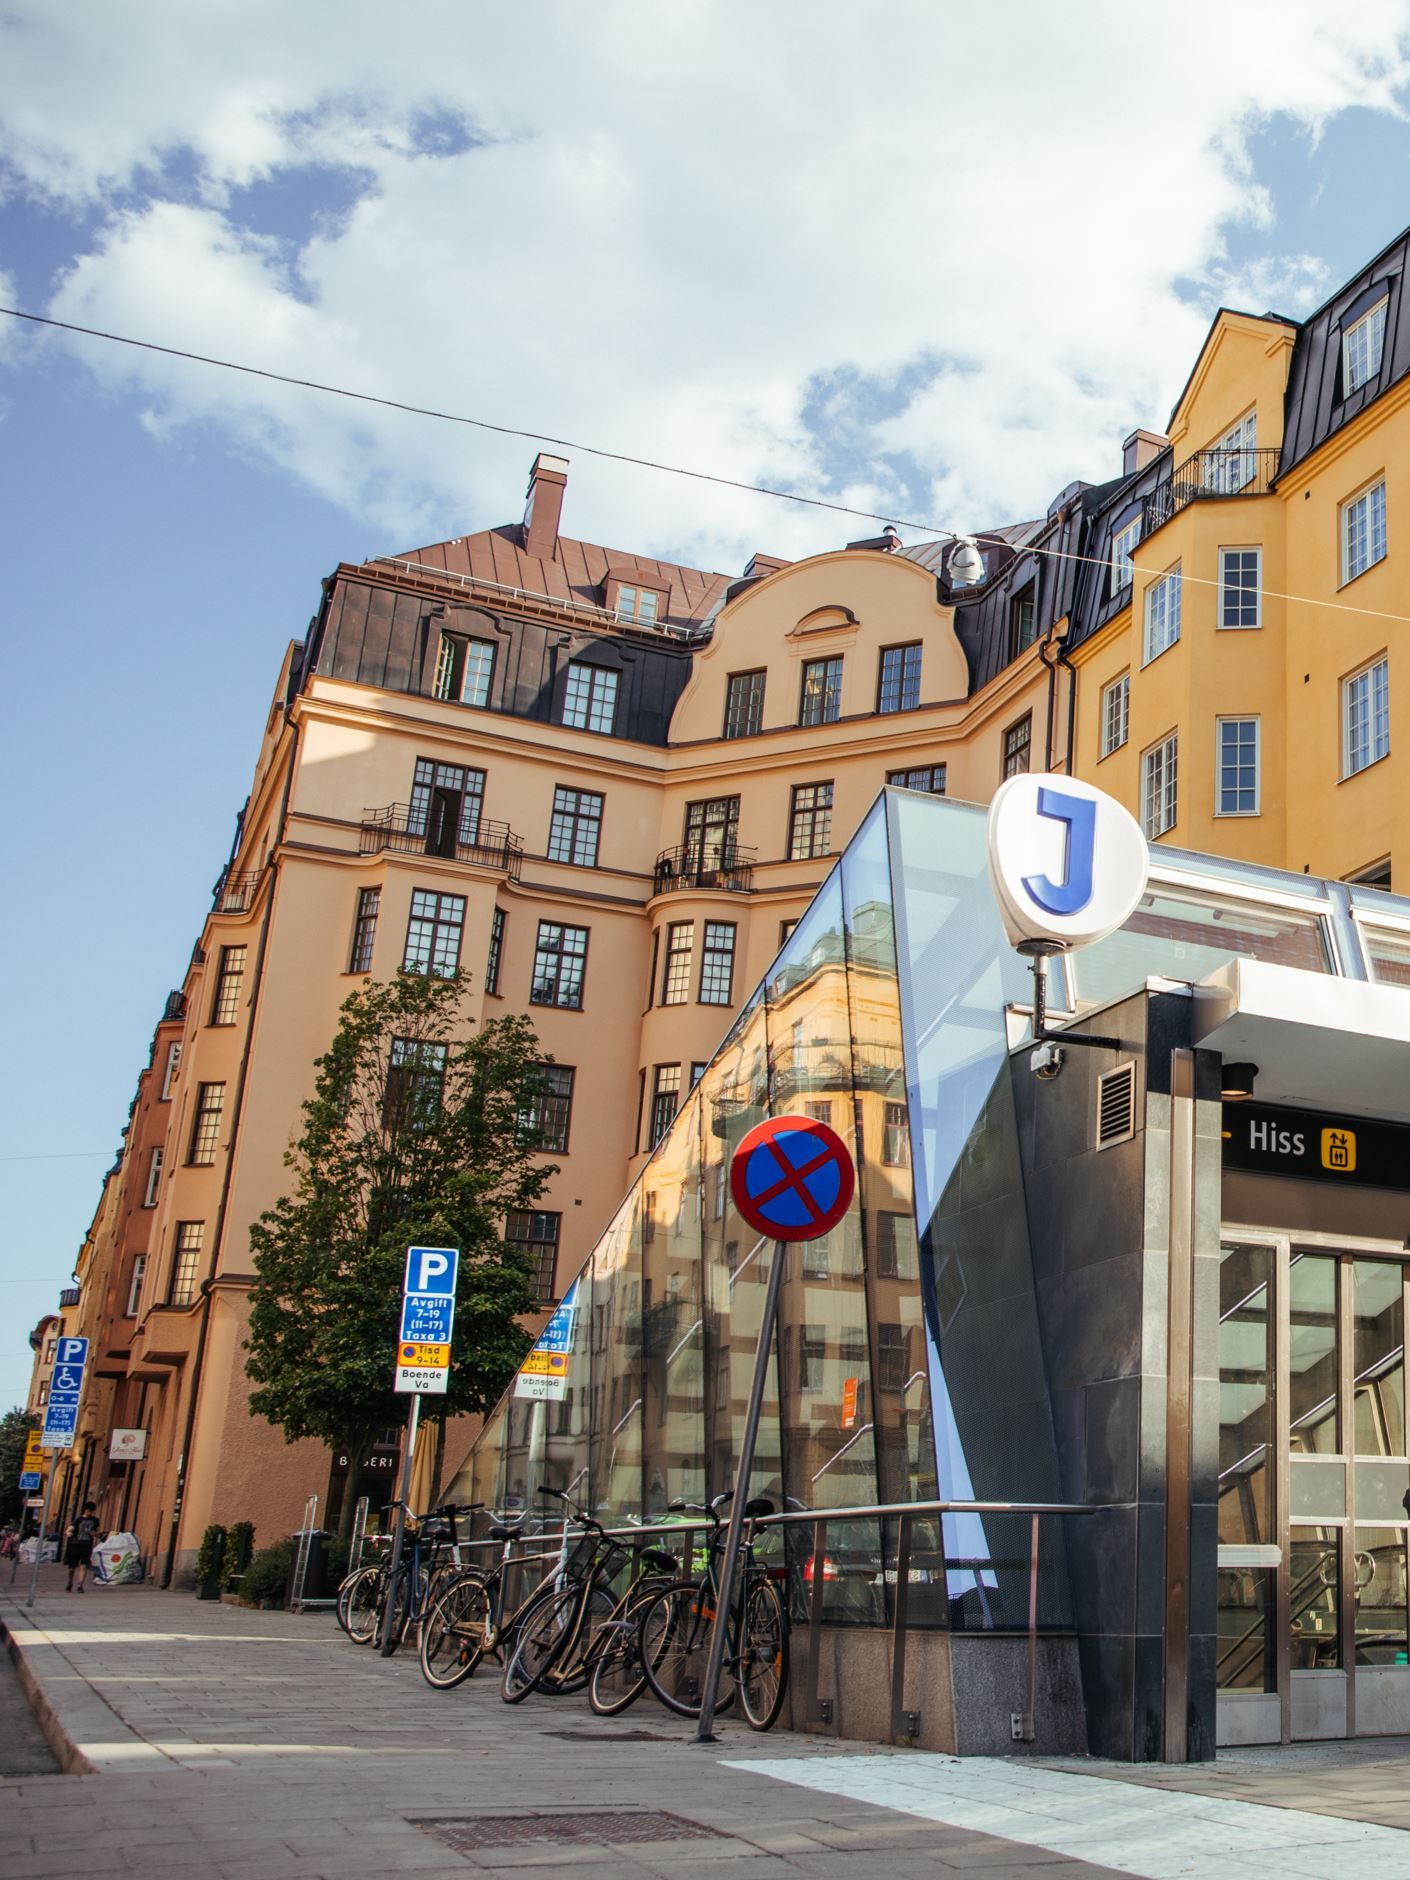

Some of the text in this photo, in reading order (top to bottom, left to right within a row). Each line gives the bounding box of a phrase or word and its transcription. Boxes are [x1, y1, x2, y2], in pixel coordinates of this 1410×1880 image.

[1020, 786, 1098, 917] J
[1250, 1120, 1306, 1156] Hiss
[418, 1253, 448, 1290] P
[411, 1297, 448, 1309] Avgift
[416, 1309, 441, 1319] 7-19
[410, 1319, 444, 1330] (11-17)
[406, 1330, 446, 1341] Taxa 3
[63, 1340, 83, 1362] P
[419, 1345, 441, 1354] Tisd
[416, 1356, 440, 1365] 9-14
[402, 1369, 442, 1379] Boende
[415, 1381, 429, 1389] Va
[340, 1456, 393, 1468] BERI
